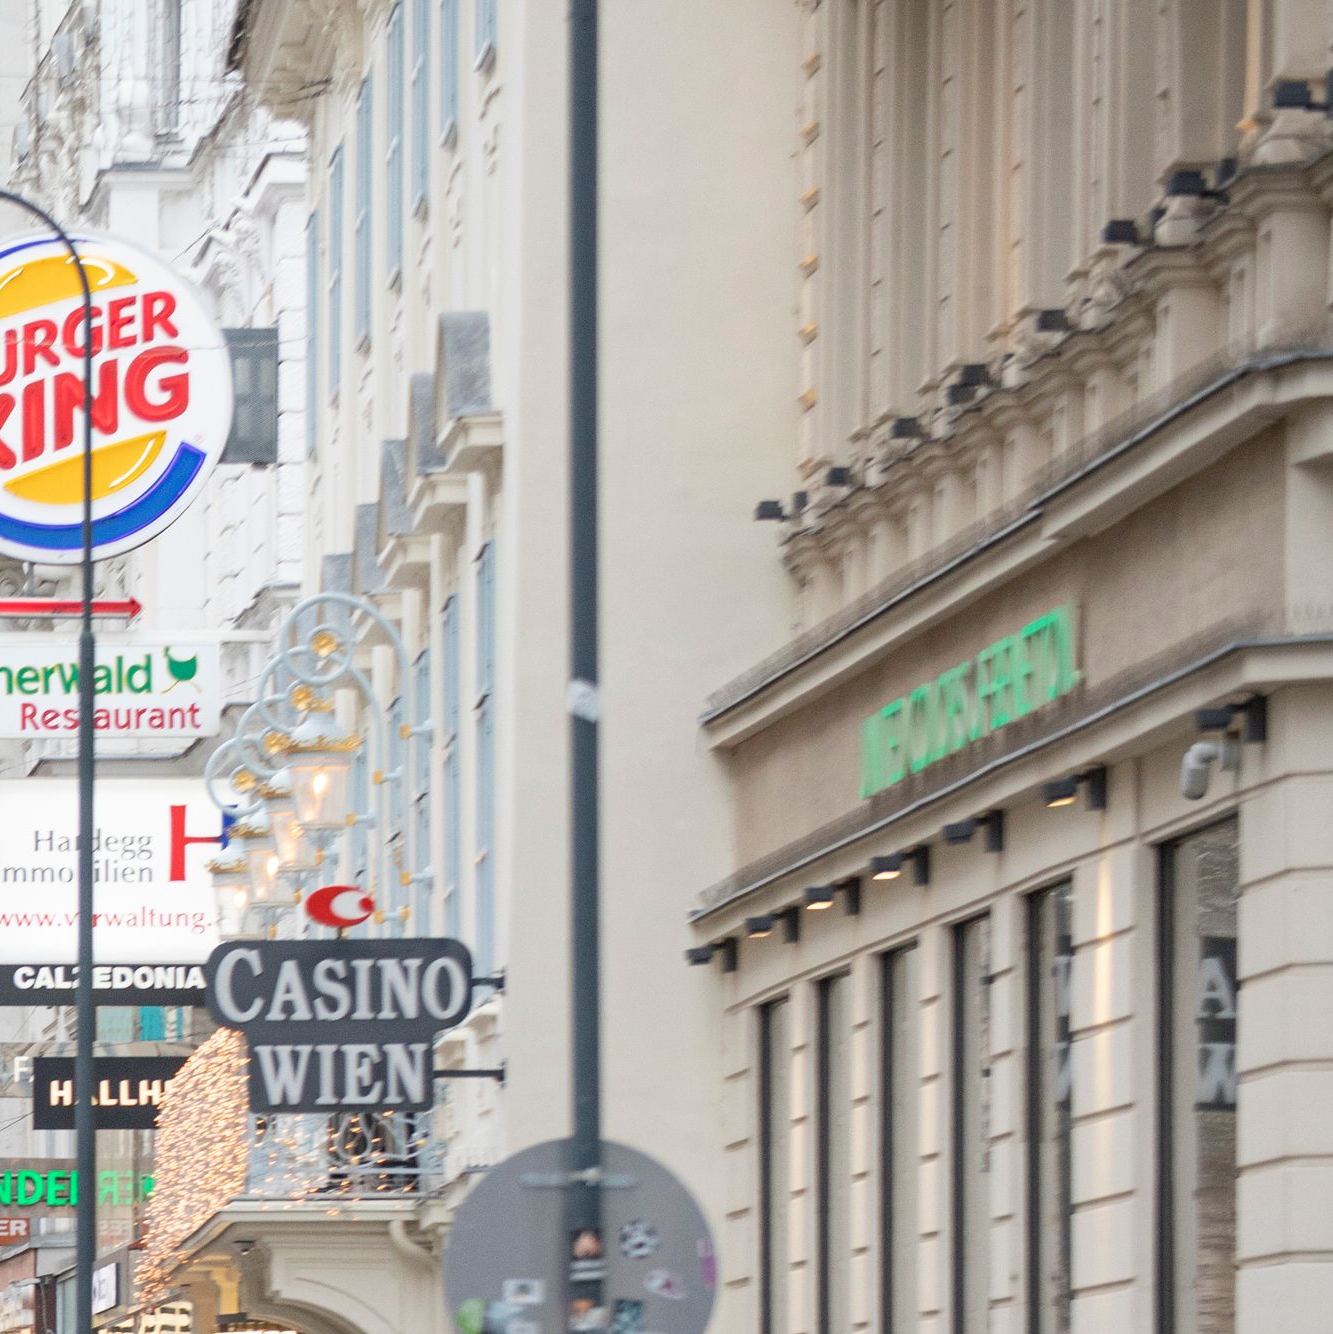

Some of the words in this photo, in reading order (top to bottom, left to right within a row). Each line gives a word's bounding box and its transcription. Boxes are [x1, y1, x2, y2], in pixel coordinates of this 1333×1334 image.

[20, 702, 201, 730] Resaurant
[214, 947, 469, 1023] CASINO
[12, 1055, 35, 1083] F
[254, 1042, 427, 1106] WIEN
